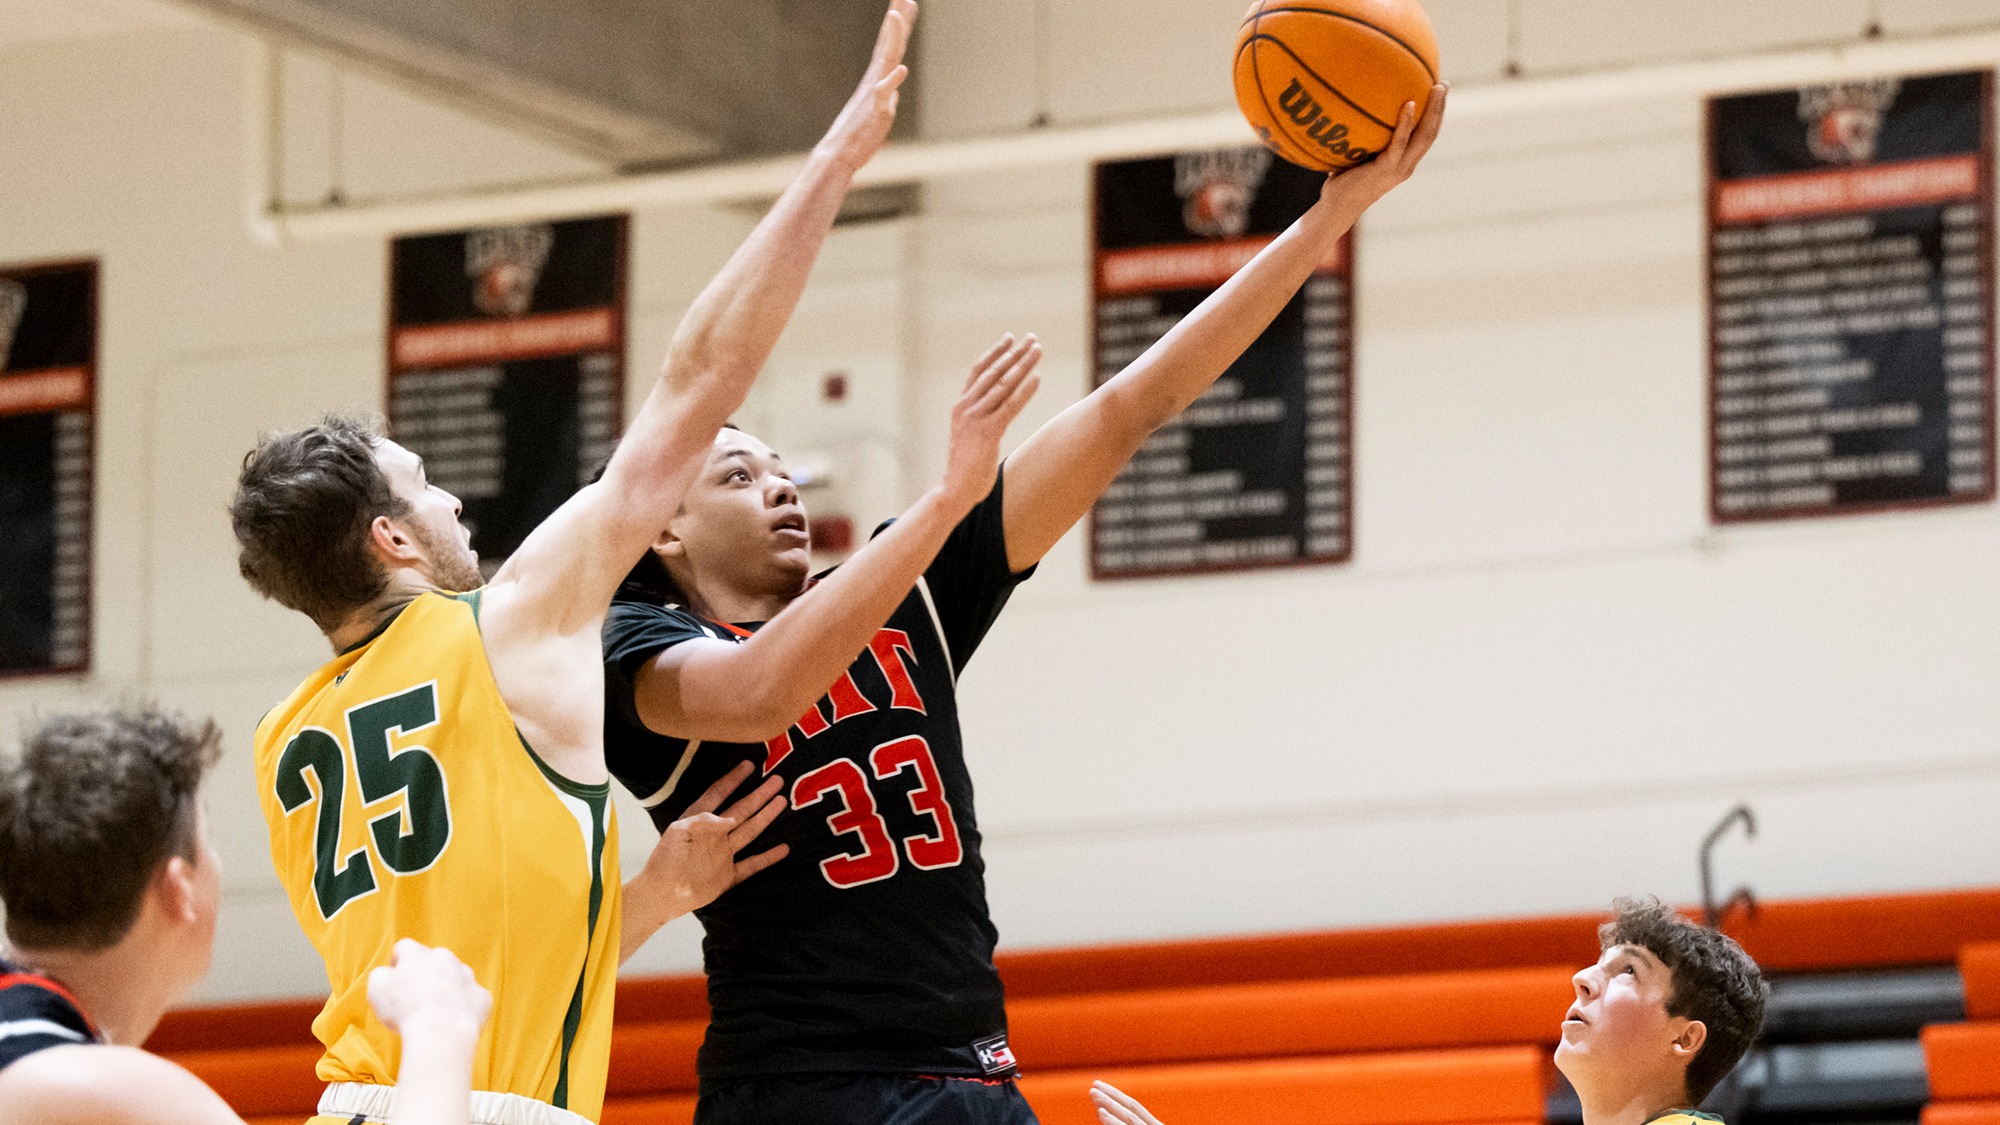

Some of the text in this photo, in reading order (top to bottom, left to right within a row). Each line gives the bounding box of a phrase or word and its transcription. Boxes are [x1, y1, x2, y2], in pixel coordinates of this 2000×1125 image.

[1279, 77, 1373, 163] Wilso
[275, 679, 452, 922] 25
[791, 734, 963, 889] 33
